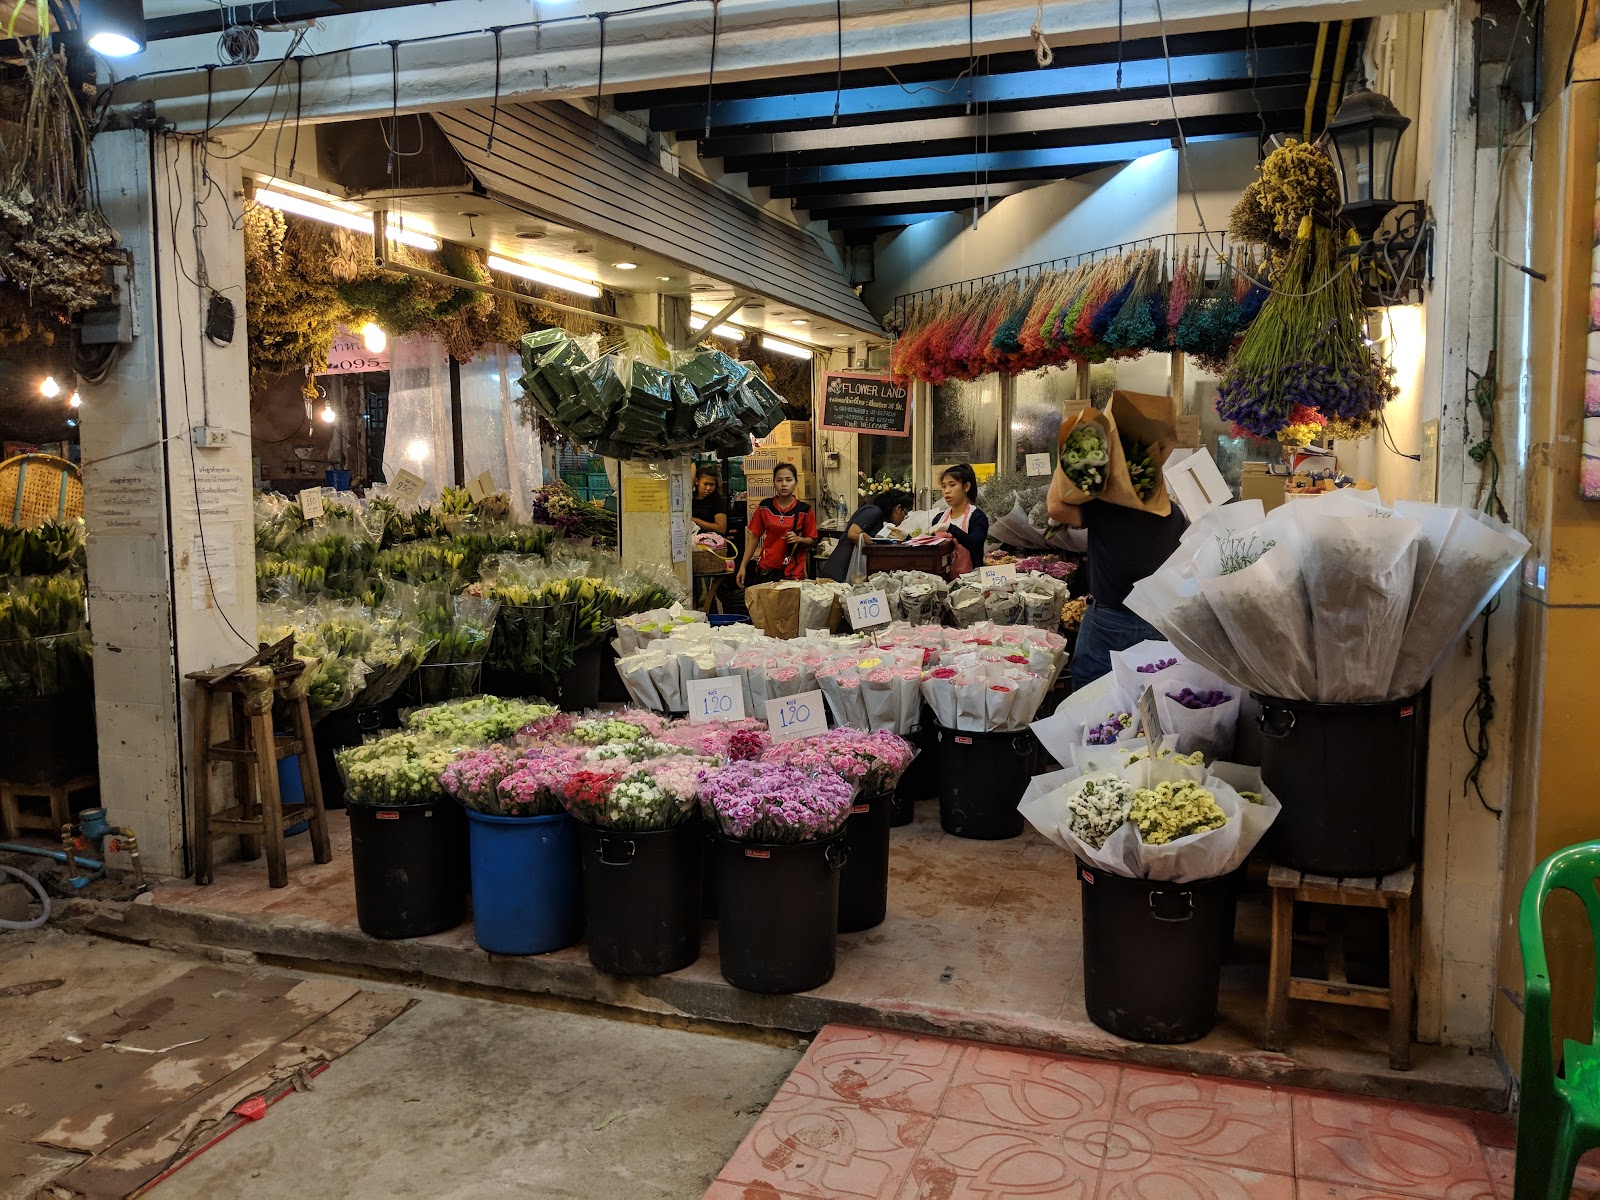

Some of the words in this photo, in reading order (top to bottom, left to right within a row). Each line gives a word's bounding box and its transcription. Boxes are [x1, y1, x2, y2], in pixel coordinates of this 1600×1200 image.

[842, 383, 878, 397] FLOWER
[881, 386, 906, 399] LAND
[396, 481, 413, 496] 250
[992, 575, 1007, 585] 150
[857, 603, 880, 619] 110
[703, 695, 732, 715] 120
[780, 704, 811, 728] 120
[543, 745, 556, 756] QC
